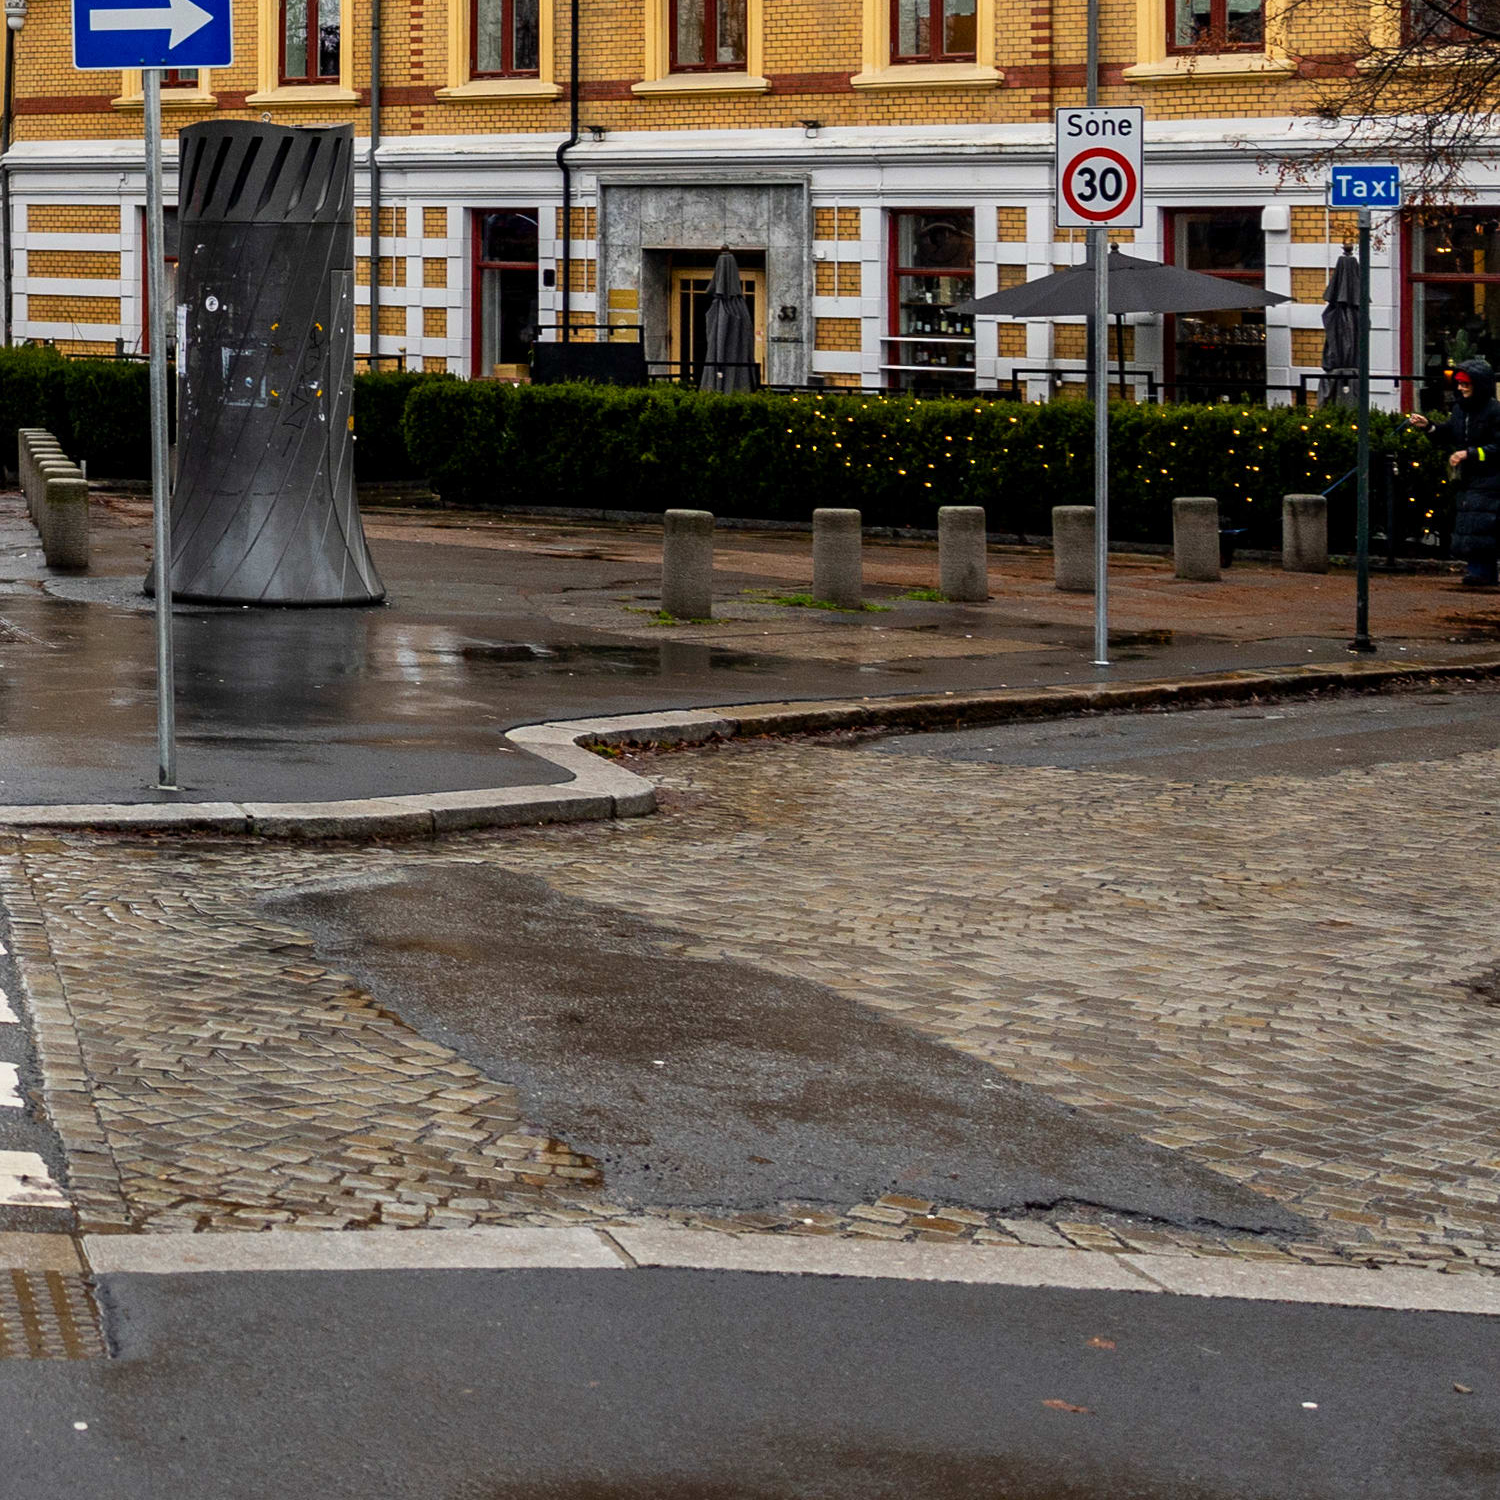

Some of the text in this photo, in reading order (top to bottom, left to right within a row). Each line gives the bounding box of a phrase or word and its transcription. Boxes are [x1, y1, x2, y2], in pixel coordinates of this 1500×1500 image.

[1066, 114, 1132, 137] Sone
[1077, 167, 1122, 202] 30
[1336, 175, 1396, 197] Taxi
[777, 306, 798, 322] 33
